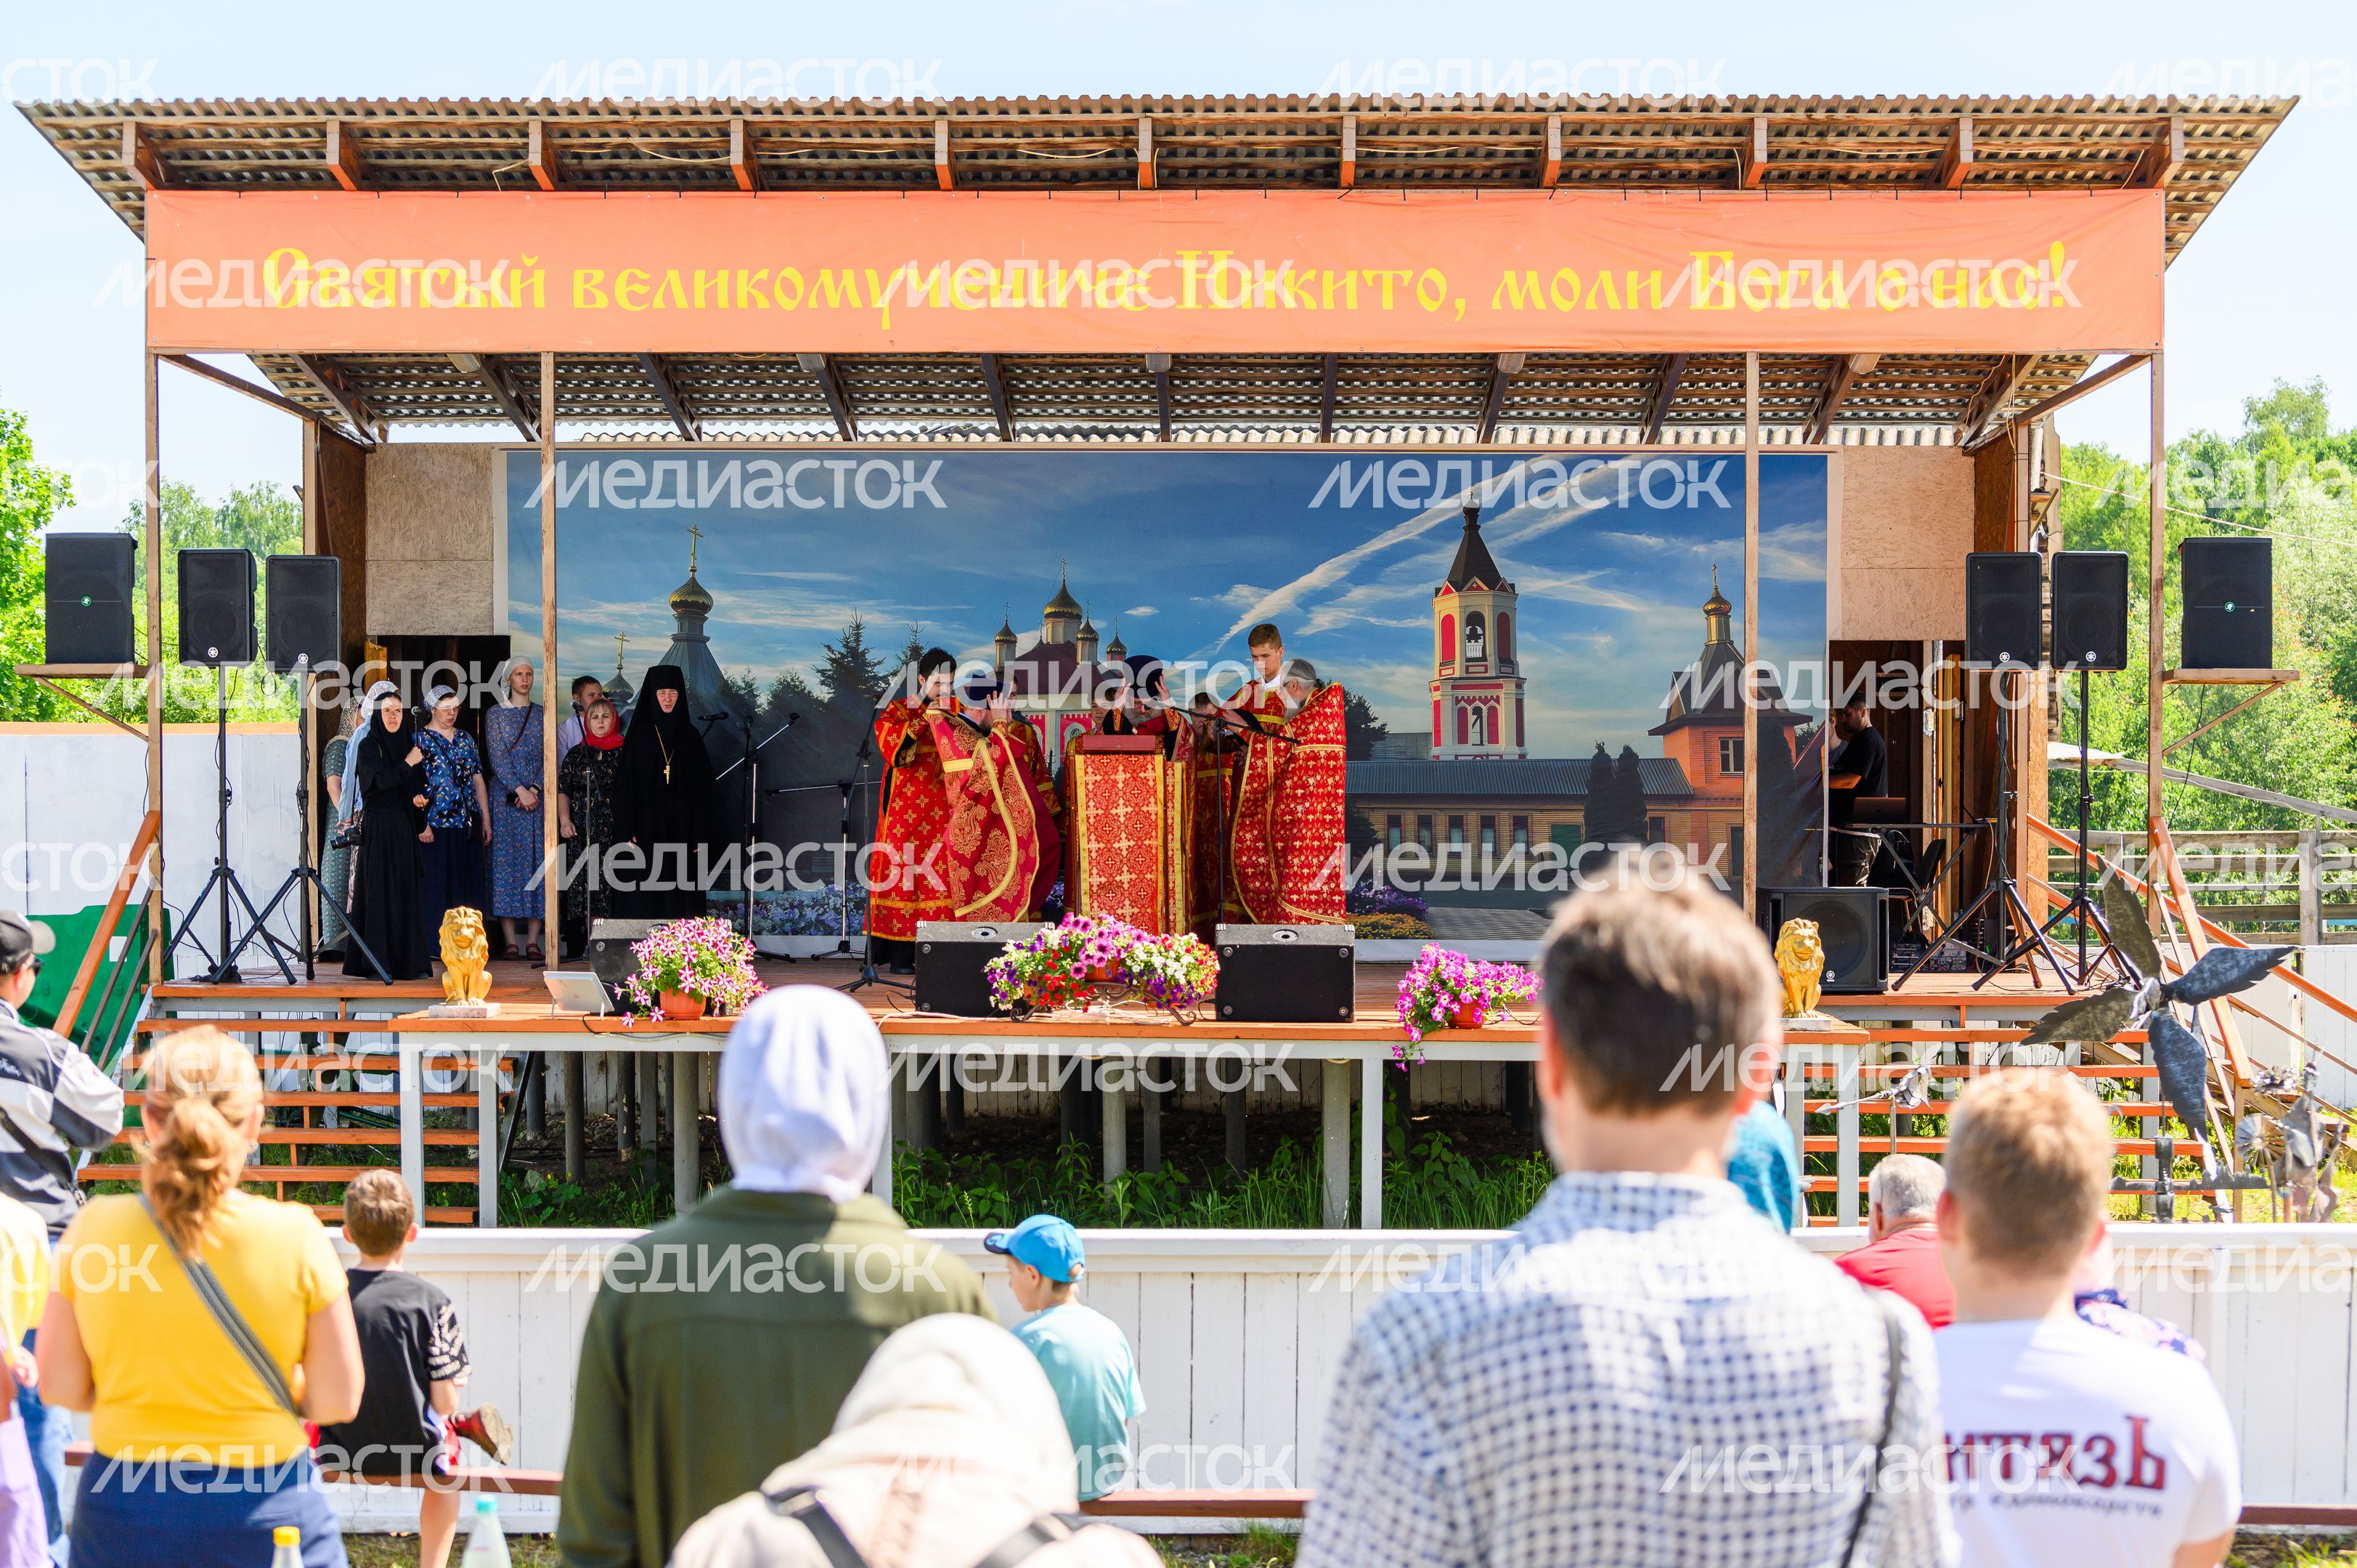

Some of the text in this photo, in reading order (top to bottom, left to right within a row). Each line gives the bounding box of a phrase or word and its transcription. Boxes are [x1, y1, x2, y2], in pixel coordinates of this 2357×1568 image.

[263, 247, 545, 309] Святый
[1176, 250, 1466, 322] Никито,
[1492, 267, 1662, 312] моли
[1689, 251, 1851, 312] Бога
[1876, 267, 1906, 311] о
[1933, 240, 2065, 311] нас!
[1944, 1414, 2166, 1490] итязь
